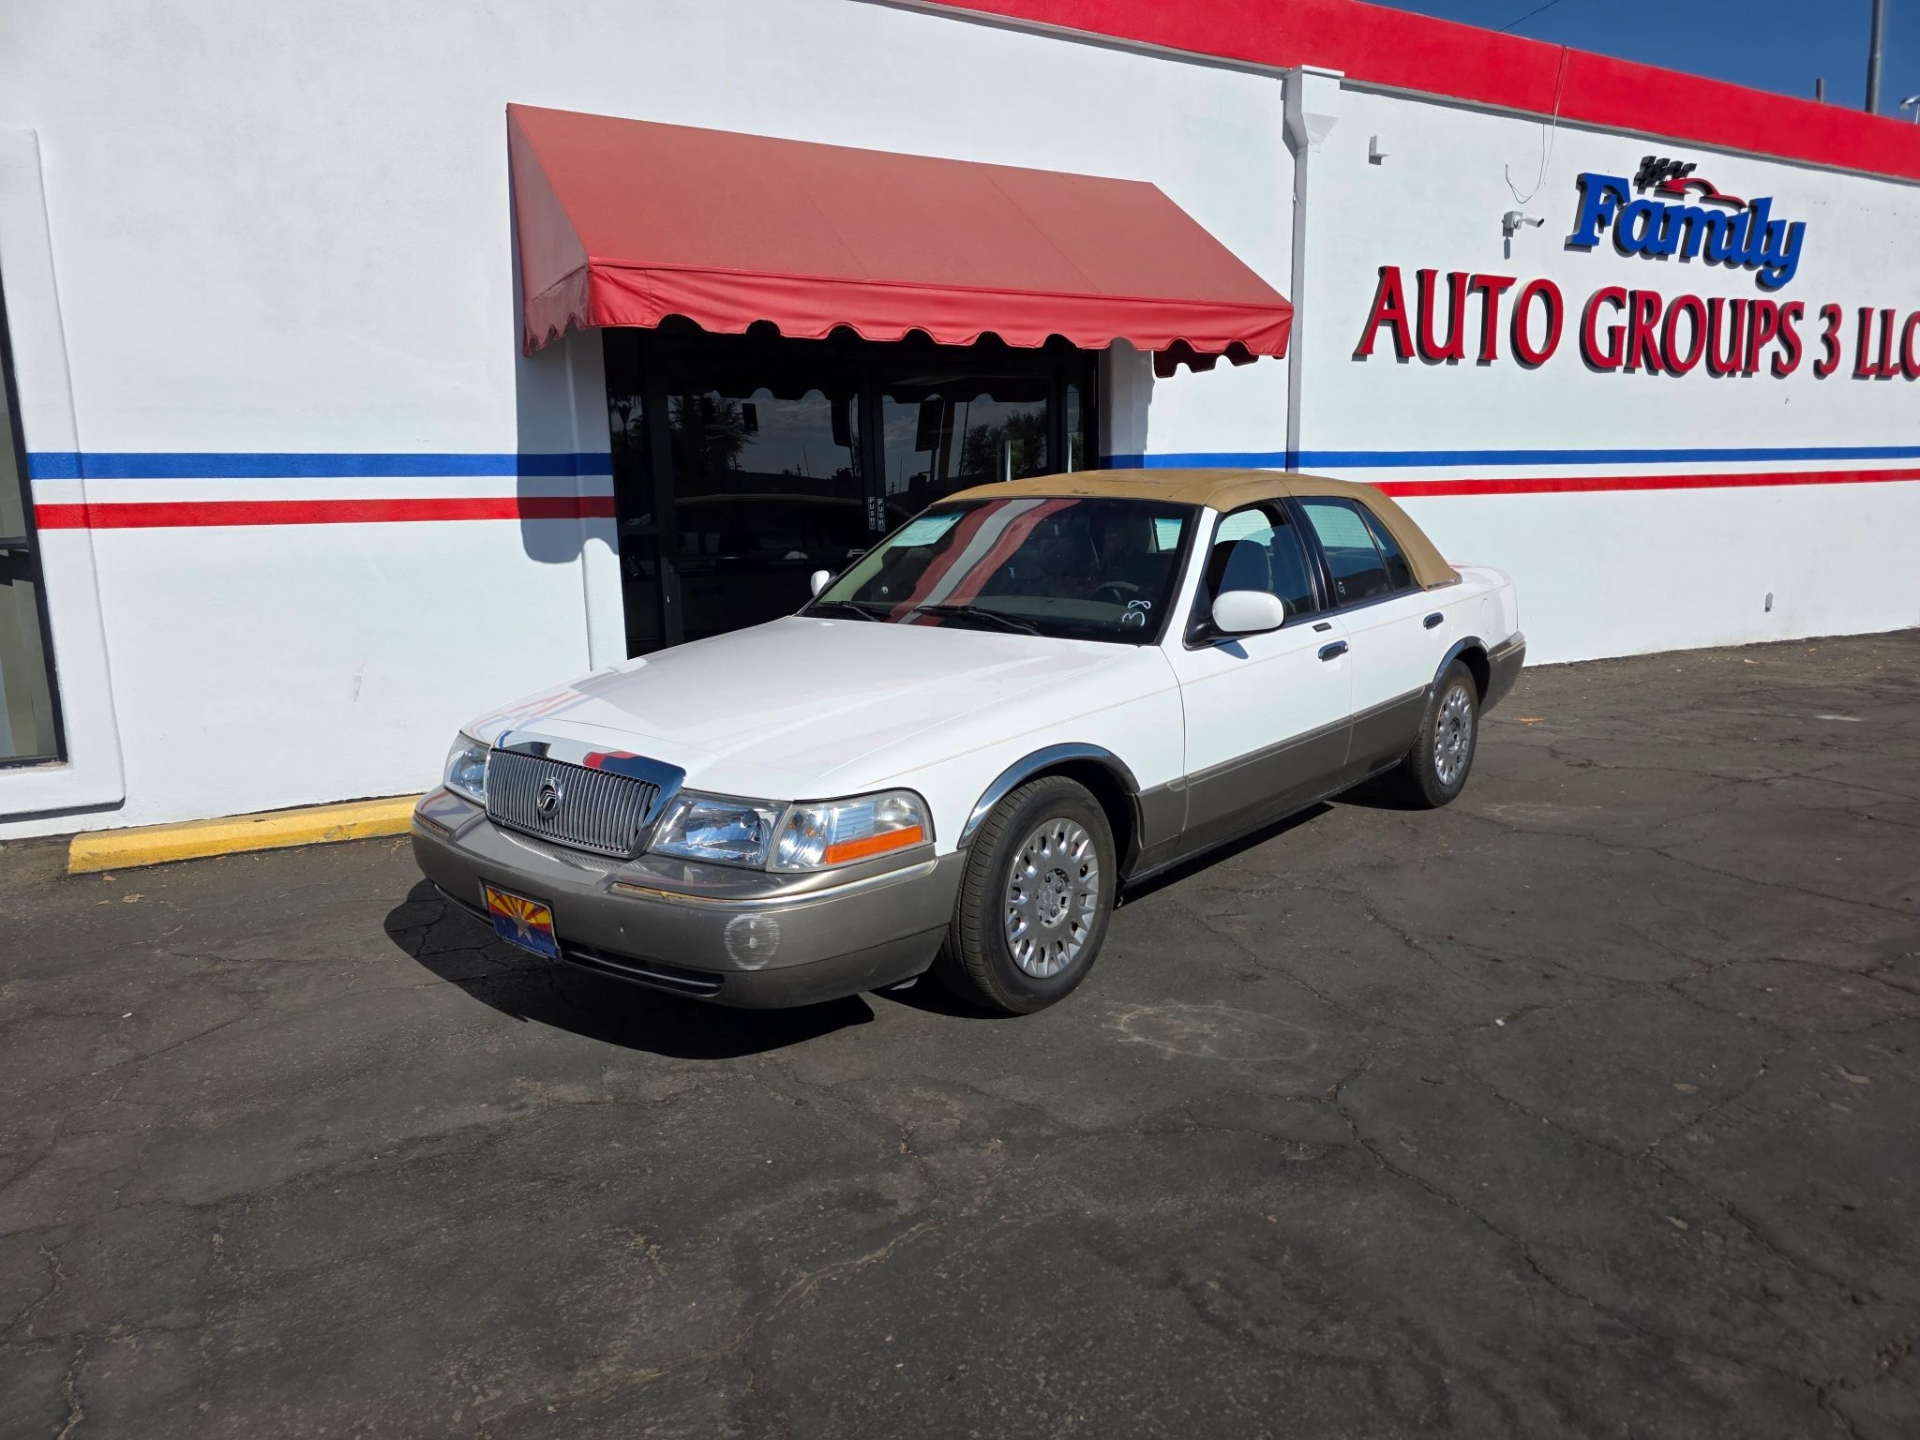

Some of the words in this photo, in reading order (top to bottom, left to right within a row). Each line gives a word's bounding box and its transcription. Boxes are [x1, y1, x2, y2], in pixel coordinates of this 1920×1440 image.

[1567, 172, 1807, 290] Family
[1354, 265, 1563, 367] AUTO
[1580, 286, 1804, 377] GROUPS
[1814, 303, 1842, 379] 3
